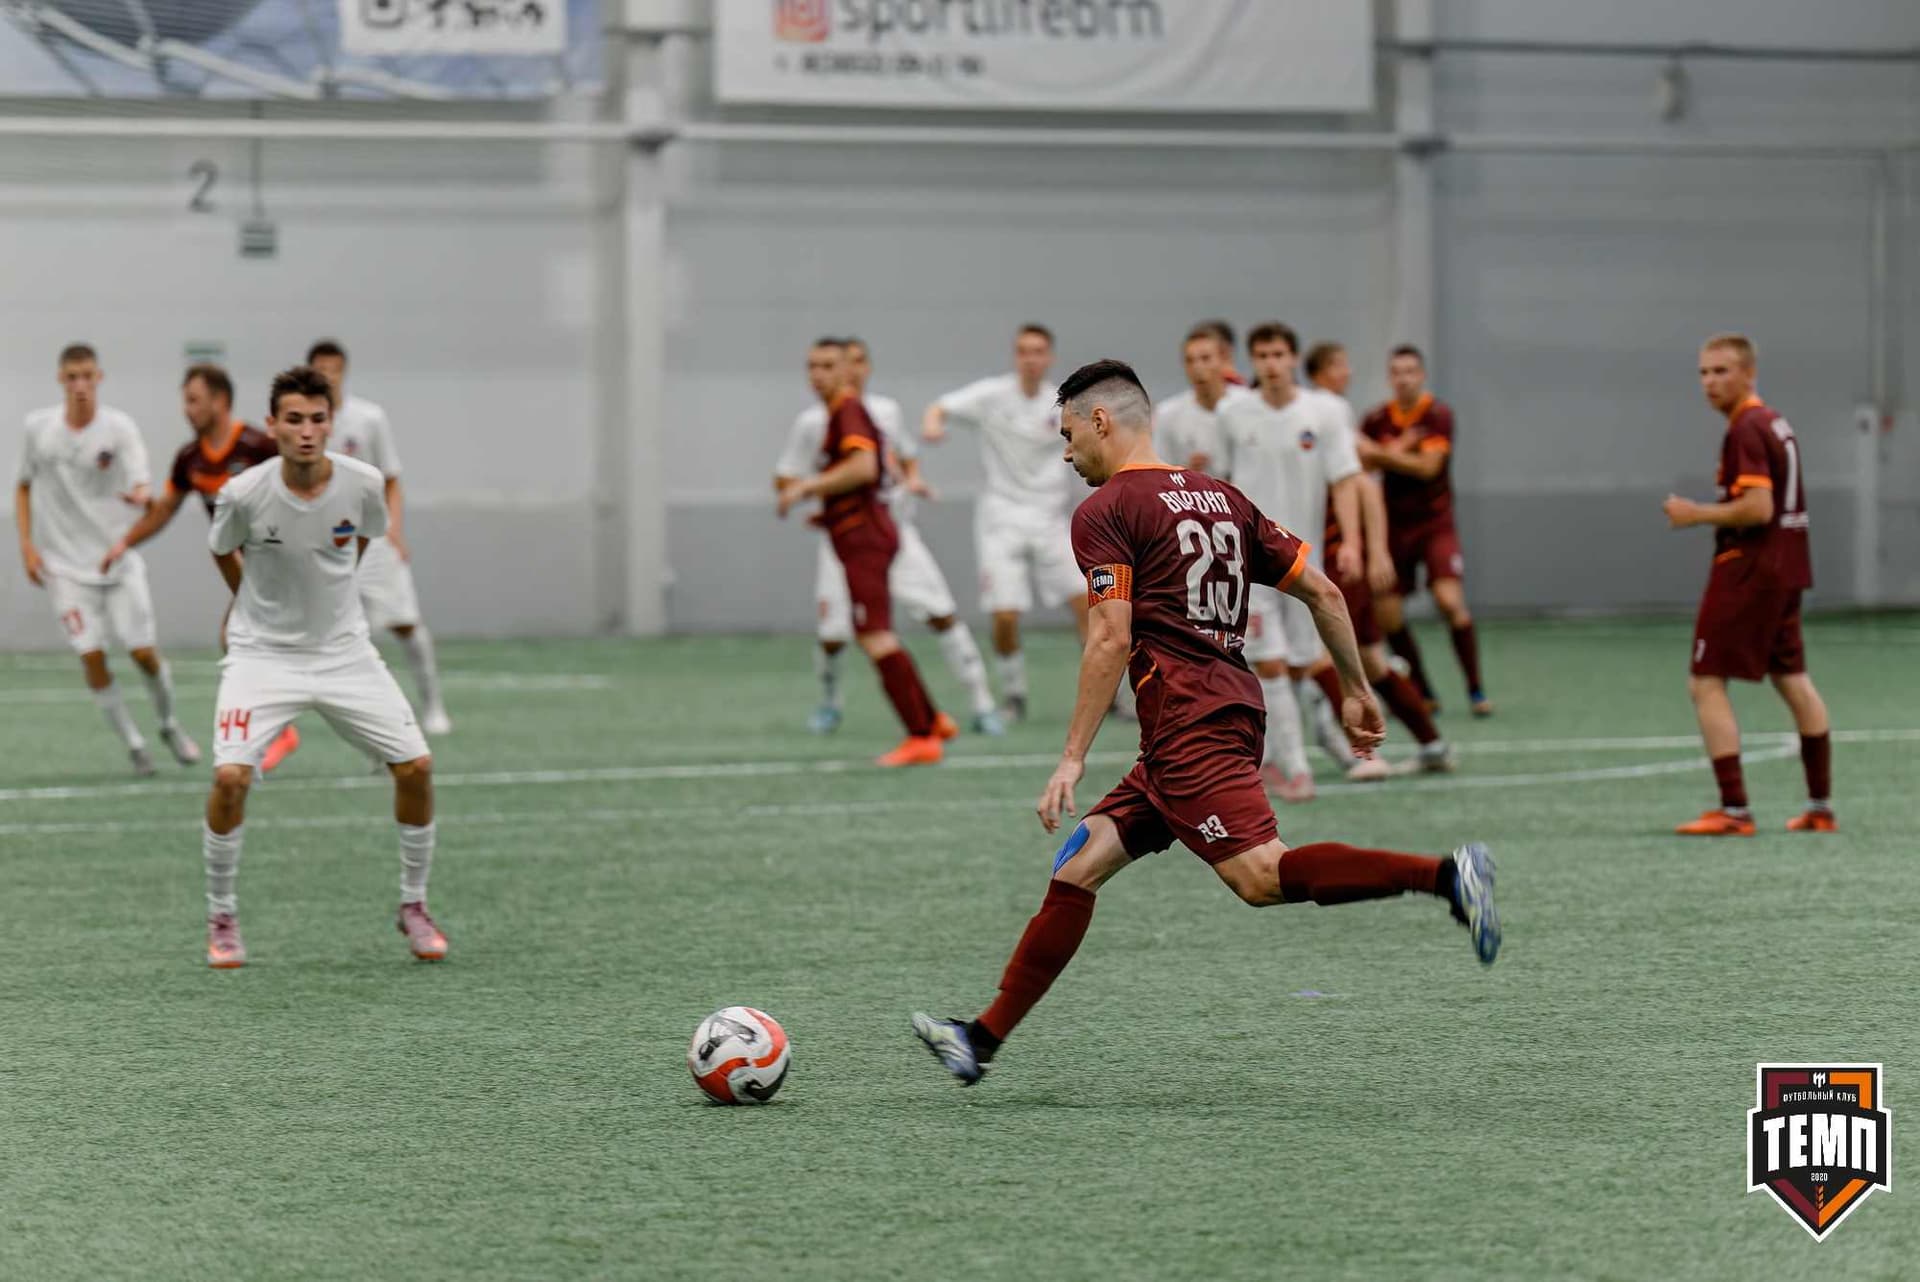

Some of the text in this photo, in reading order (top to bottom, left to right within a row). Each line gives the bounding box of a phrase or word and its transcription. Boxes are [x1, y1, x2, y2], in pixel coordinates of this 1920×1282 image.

[187, 159, 219, 214] 2
[1175, 518, 1244, 627] 23
[219, 708, 251, 741] 44
[1198, 814, 1229, 844] 23
